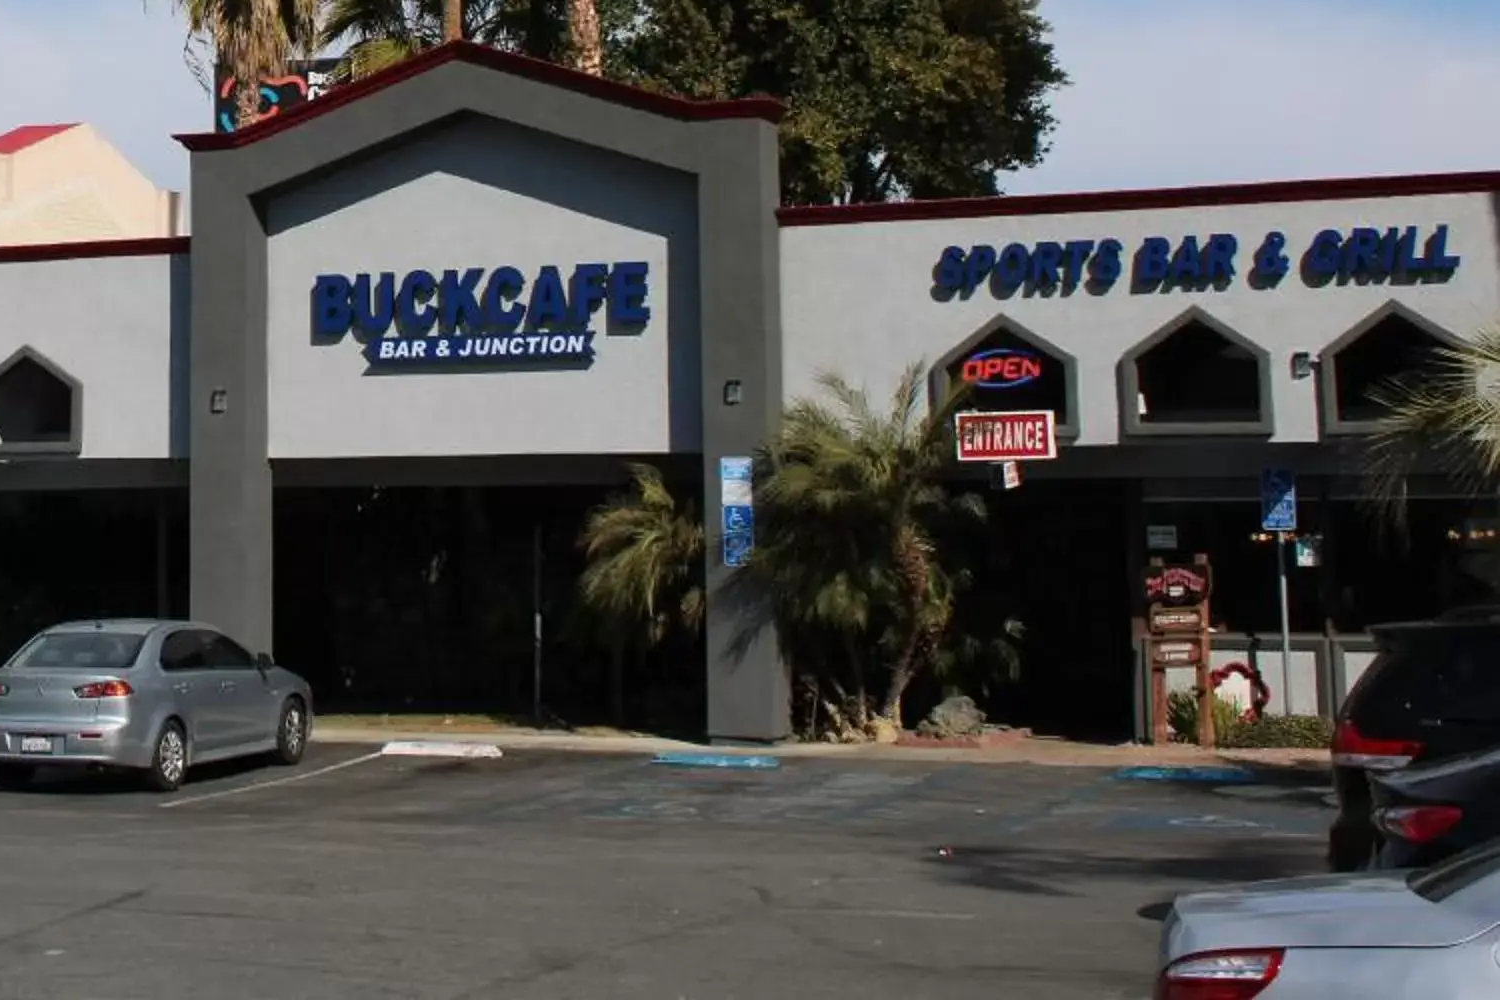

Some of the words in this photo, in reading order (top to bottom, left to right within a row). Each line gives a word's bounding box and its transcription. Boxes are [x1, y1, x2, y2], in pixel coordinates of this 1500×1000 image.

[930, 239, 1122, 302] SPORTS
[1131, 233, 1237, 294] BAR
[1248, 231, 1290, 290] &
[1301, 224, 1461, 287] GRILL
[310, 262, 651, 346] BUCKCAFE
[379, 339, 427, 359] BAR
[435, 337, 451, 357] &
[458, 336, 585, 357] JUNCTION
[962, 357, 1041, 382] OPEN
[963, 421, 1044, 451] ENTRANCE
